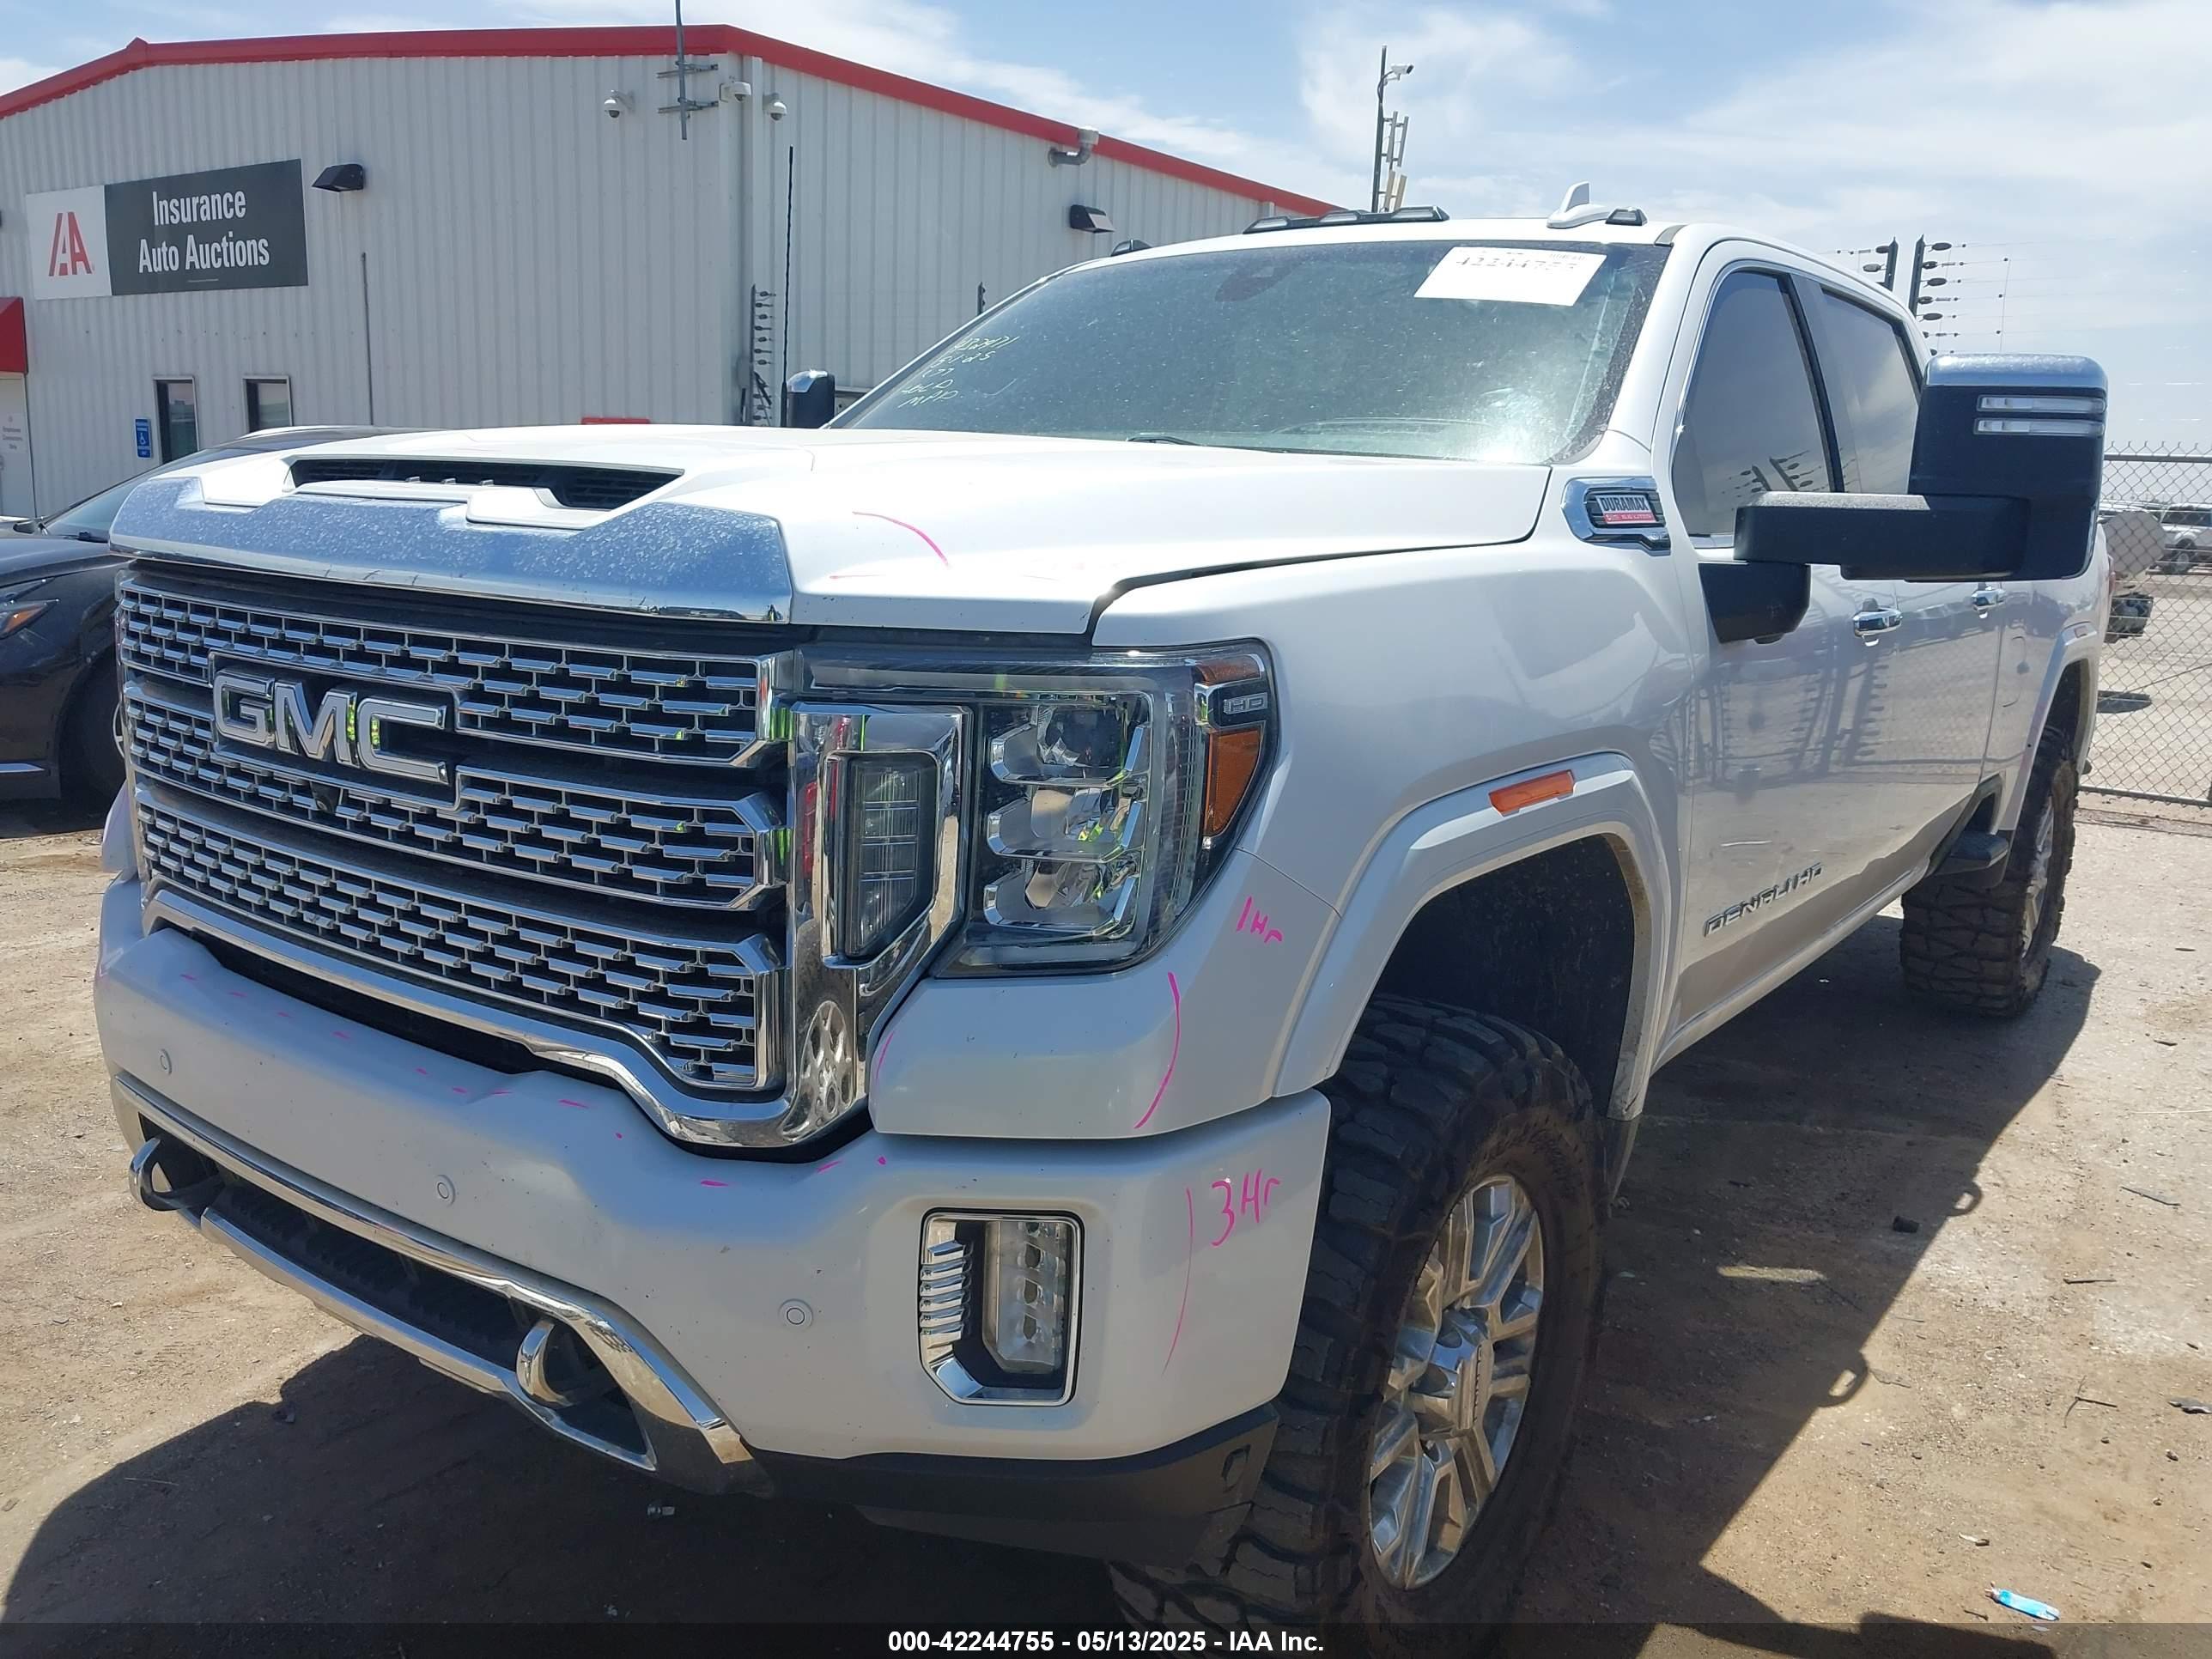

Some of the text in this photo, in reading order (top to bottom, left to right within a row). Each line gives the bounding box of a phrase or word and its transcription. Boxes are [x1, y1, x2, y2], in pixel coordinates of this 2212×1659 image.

[152, 191, 246, 226] Insurance
[138, 231, 270, 273] Auto Auctions
[1600, 496, 1650, 512] DURAMAX
[1224, 692, 1268, 714] HD
[213, 667, 448, 785] GMC
